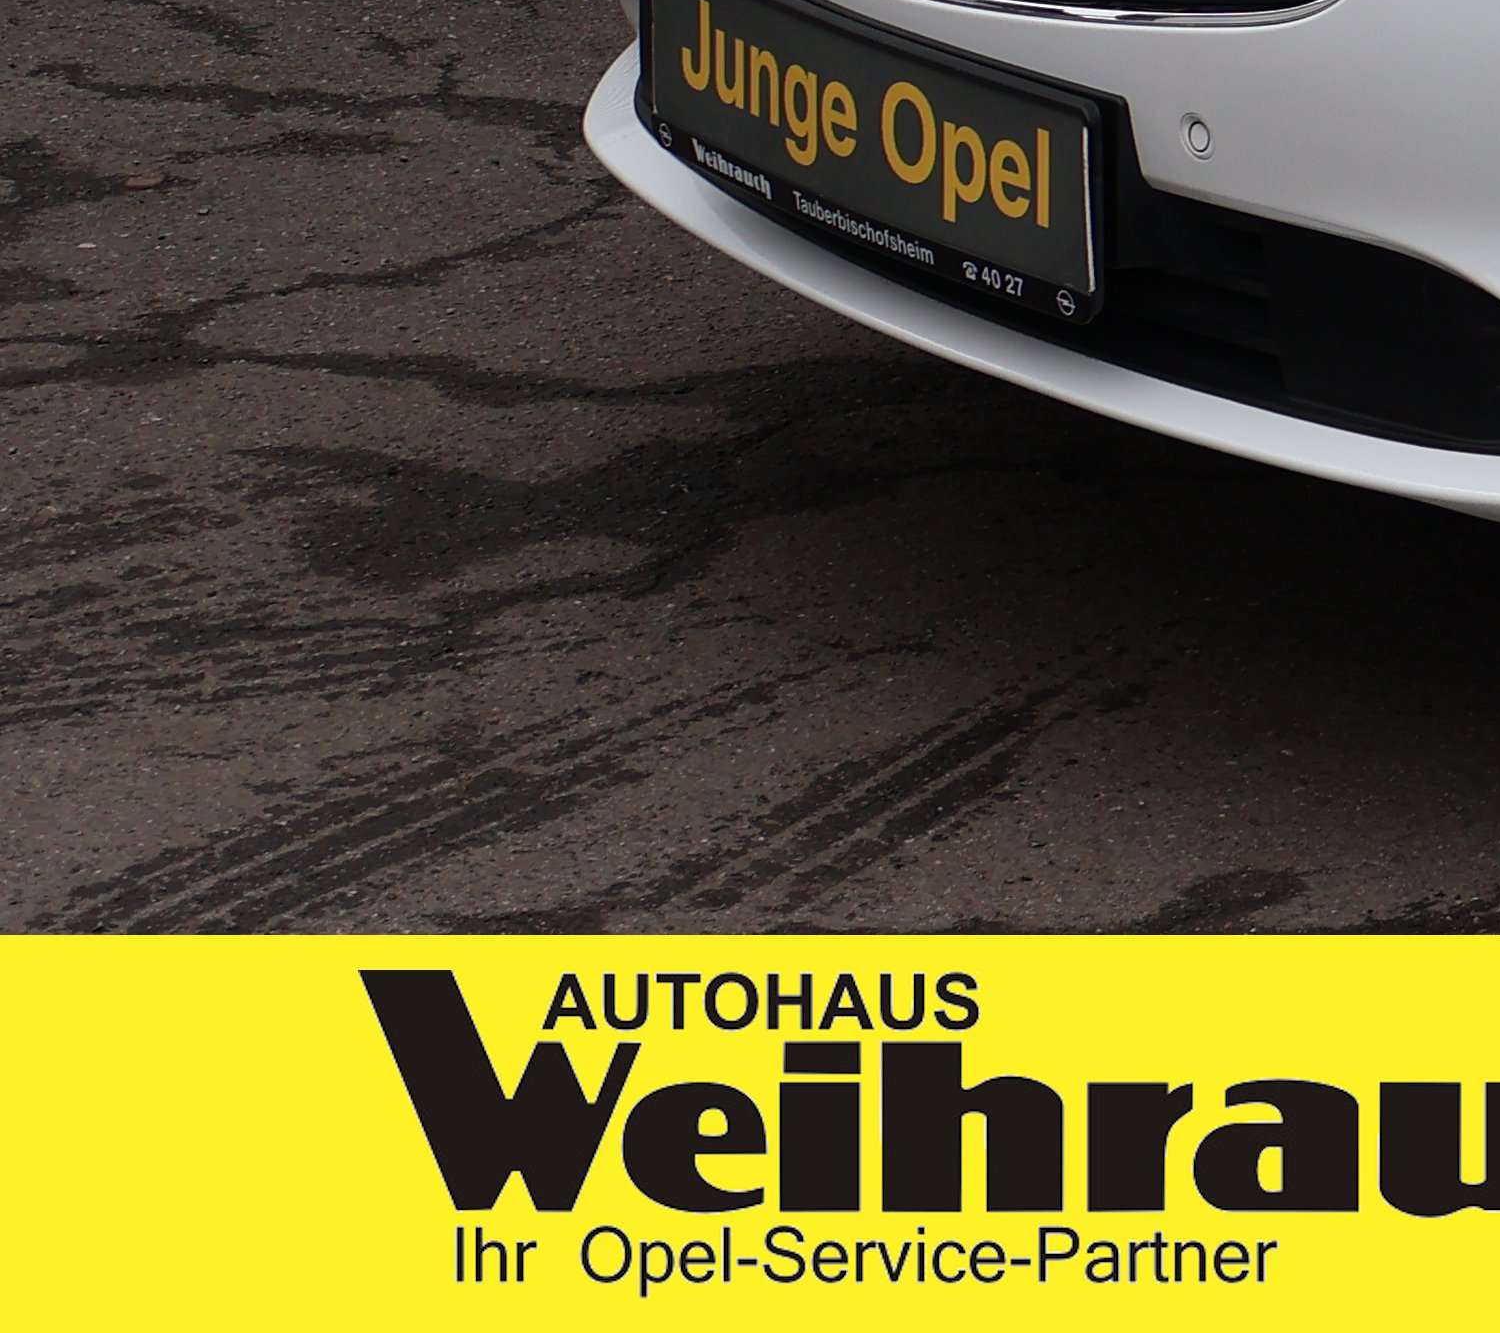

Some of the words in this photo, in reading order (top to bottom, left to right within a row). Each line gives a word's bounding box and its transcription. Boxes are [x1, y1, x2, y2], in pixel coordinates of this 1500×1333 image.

[691, 137, 773, 200] Weihrauch
[792, 190, 935, 266] Tauberbischofsheim
[981, 265, 1001, 290] 40
[1004, 273, 1025, 298] 27
[880, 80, 1051, 229] Opel
